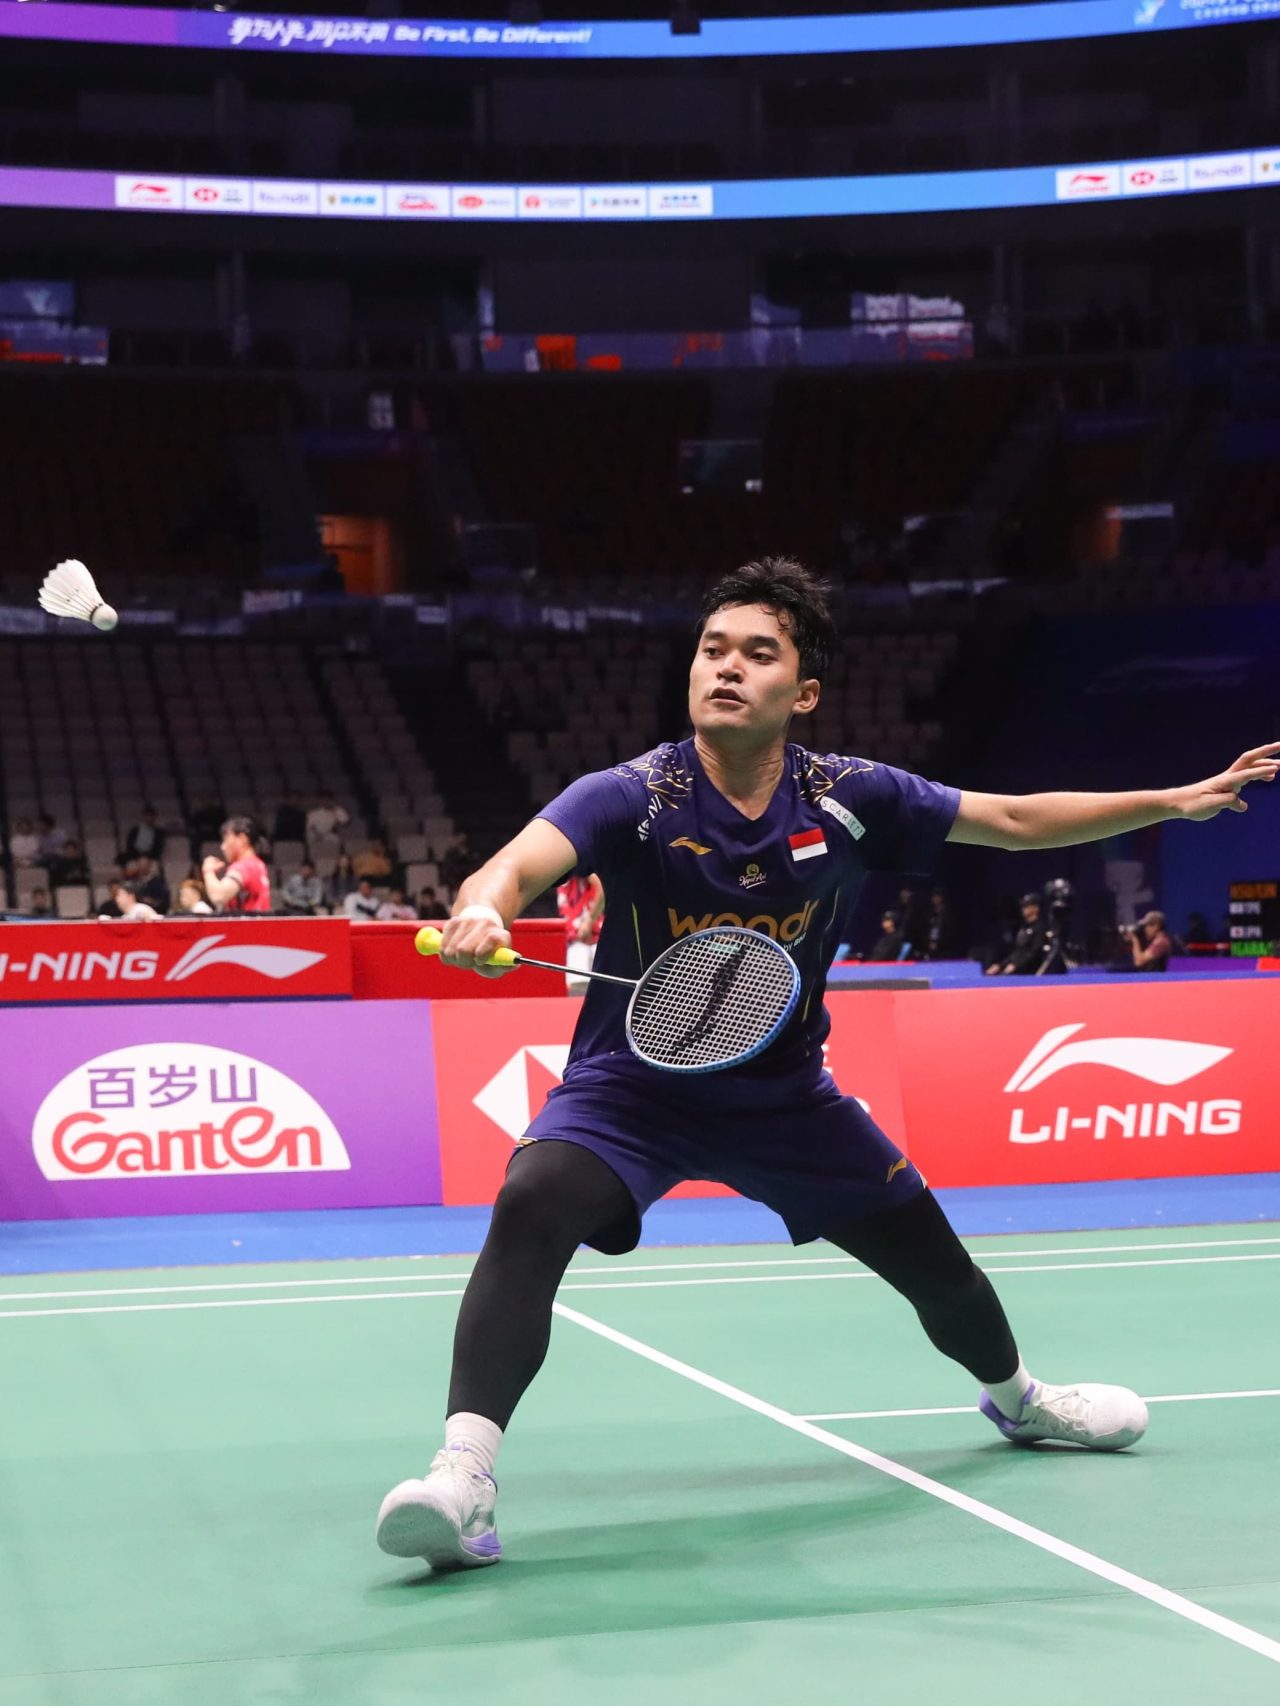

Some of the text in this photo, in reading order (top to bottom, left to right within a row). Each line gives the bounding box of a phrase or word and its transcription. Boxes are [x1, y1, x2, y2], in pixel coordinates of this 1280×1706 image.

[394, 24, 593, 44] Be First, Be Different!
[87, 1063, 259, 1109] 百岁山
[1008, 1099, 1243, 1144] LI-NING
